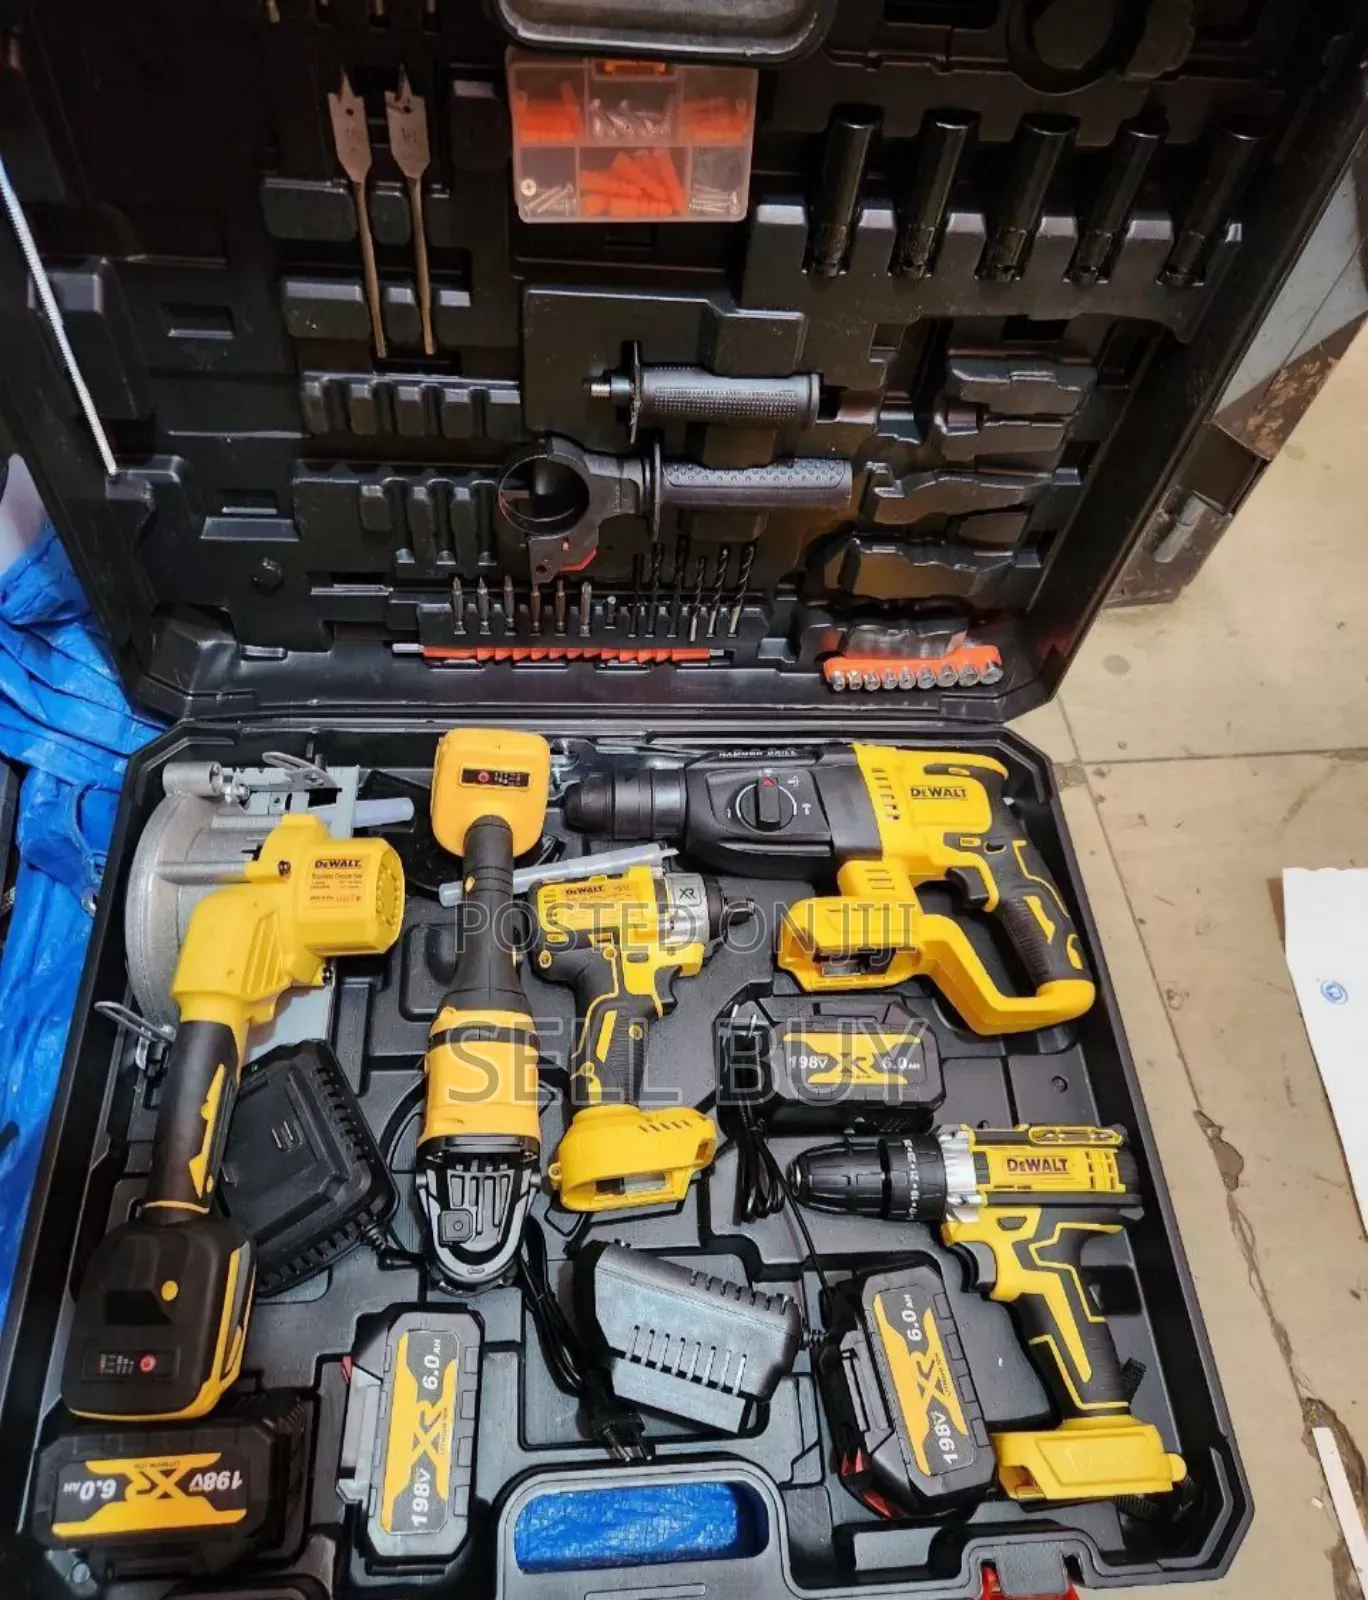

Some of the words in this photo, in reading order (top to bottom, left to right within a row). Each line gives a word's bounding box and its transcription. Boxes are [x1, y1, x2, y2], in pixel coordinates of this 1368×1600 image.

[678, 888, 697, 900] XR
[1006, 1157, 1068, 1173] DEWALT
[909, 1350, 944, 1404] XR
[411, 1400, 441, 1460] XR
[125, 1468, 188, 1500] XR
